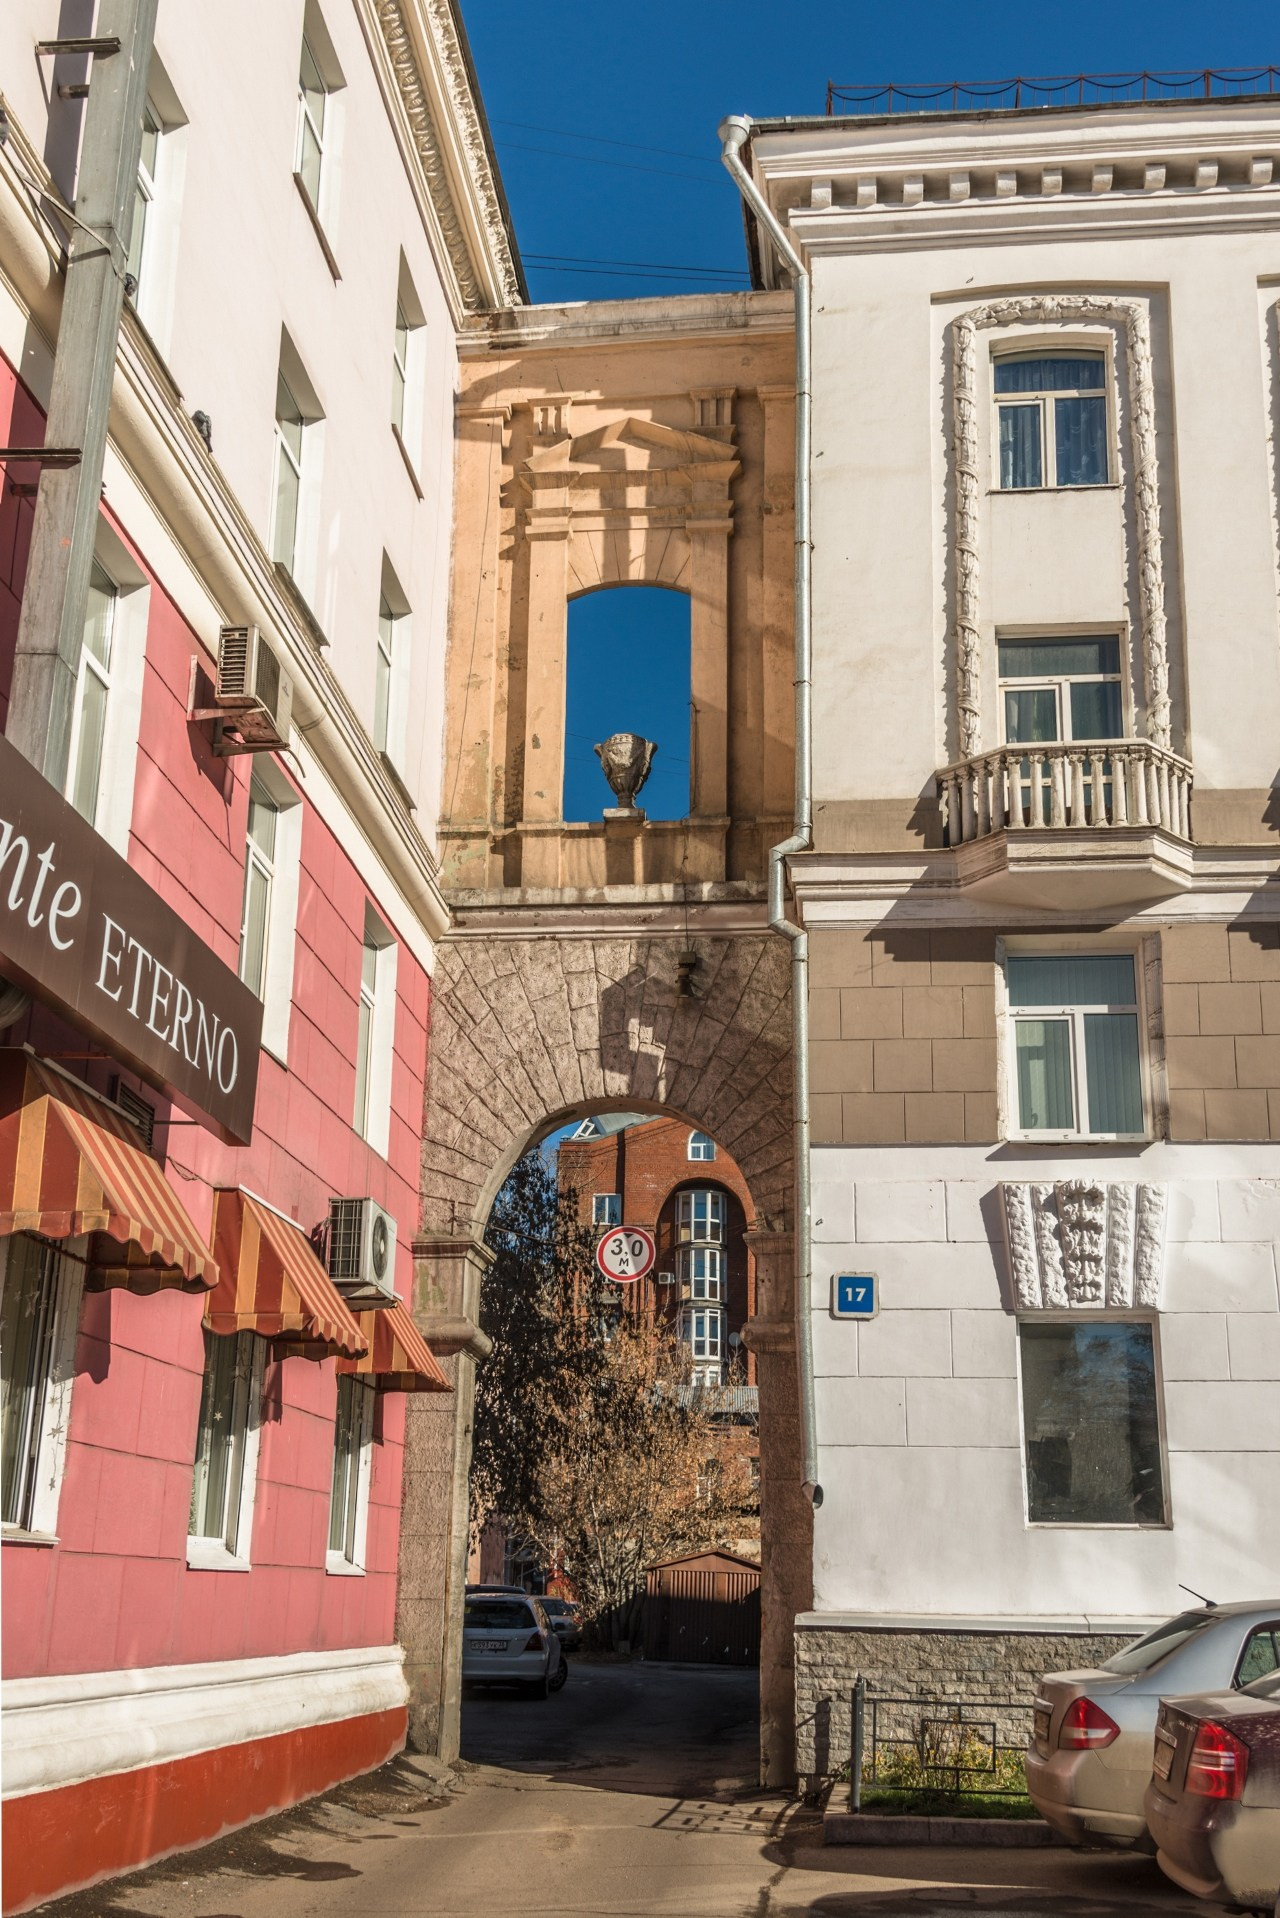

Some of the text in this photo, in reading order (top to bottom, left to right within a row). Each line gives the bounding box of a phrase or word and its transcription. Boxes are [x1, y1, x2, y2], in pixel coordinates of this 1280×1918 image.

[95, 912, 239, 1094] ETERNO
[610, 1238, 644, 1257] 3,0
[845, 1287, 867, 1302] 17
